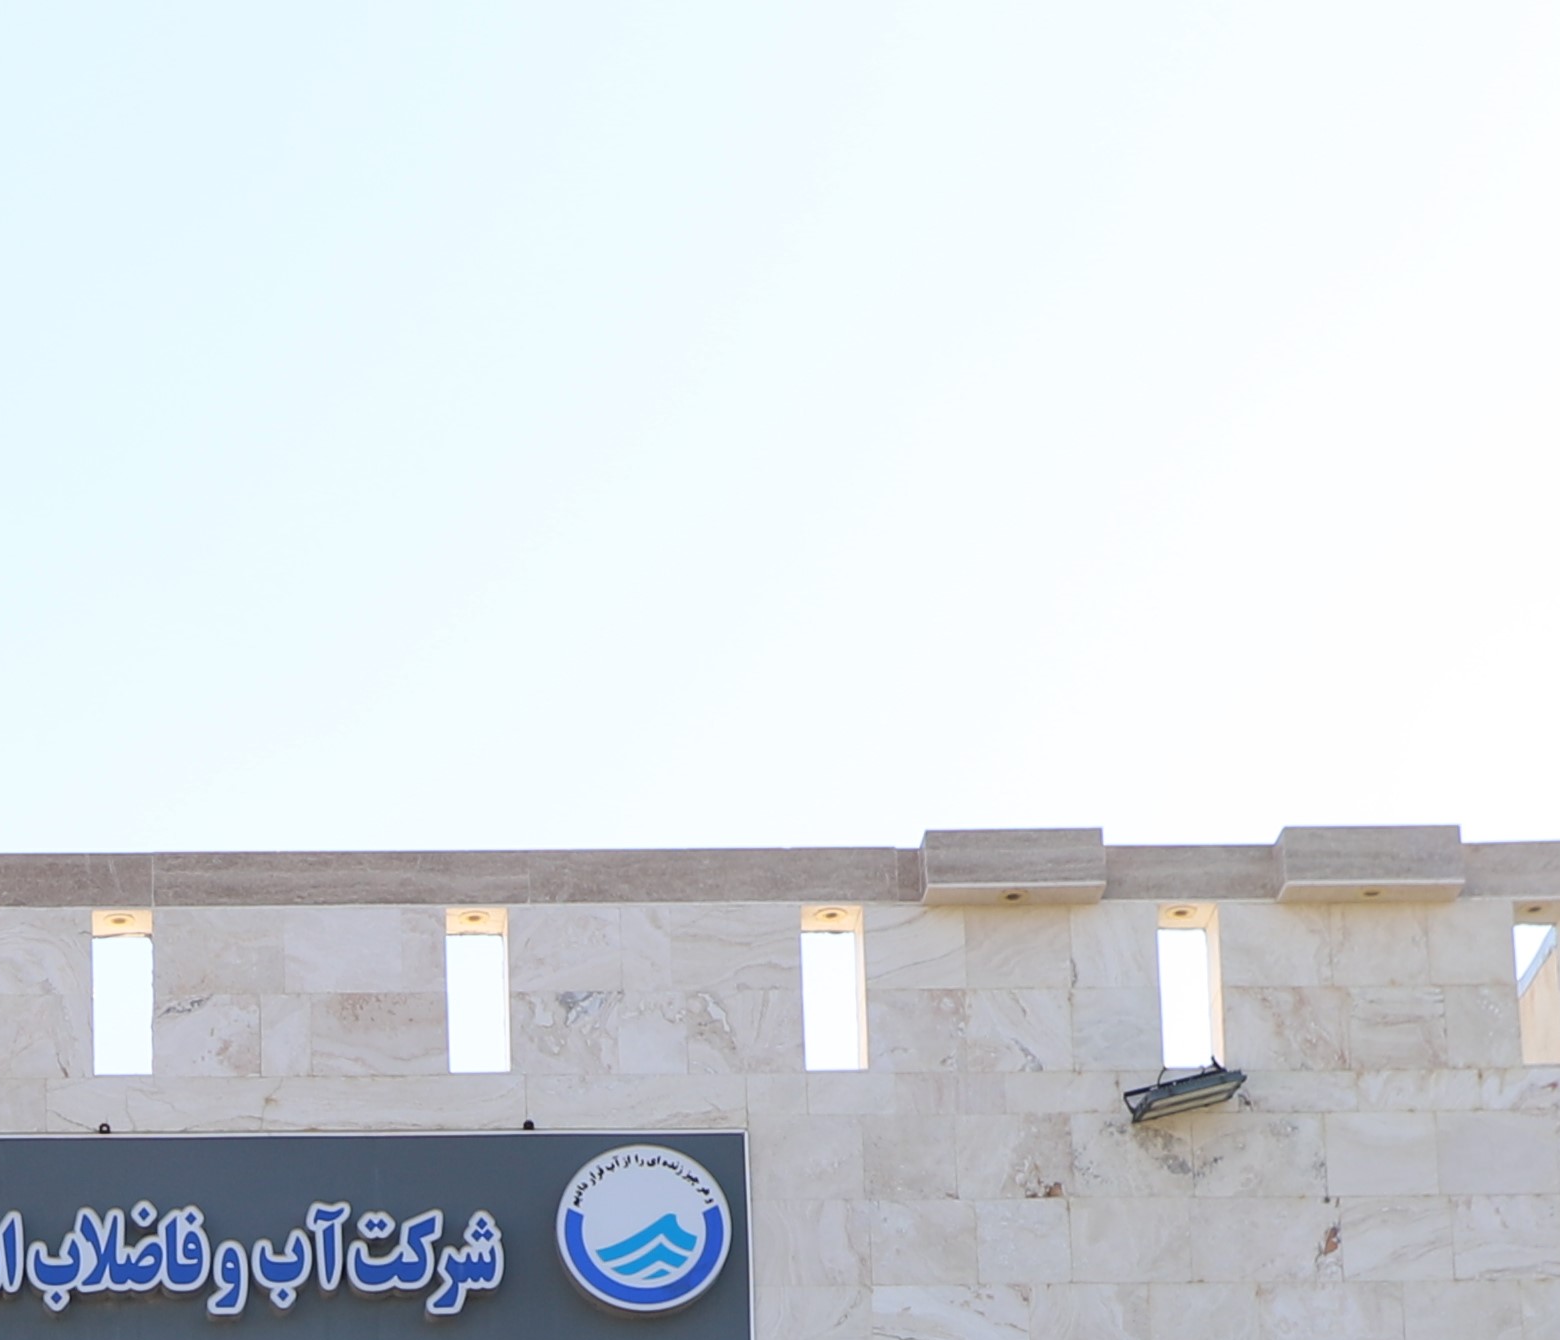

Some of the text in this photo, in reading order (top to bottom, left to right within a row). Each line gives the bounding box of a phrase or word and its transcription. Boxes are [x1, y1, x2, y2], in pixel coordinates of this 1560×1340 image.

[28, 1203, 209, 1310] فاضلاب
[209, 1241, 247, 1313] و
[253, 1203, 349, 1307] آب
[349, 1211, 502, 1313] شرکت
